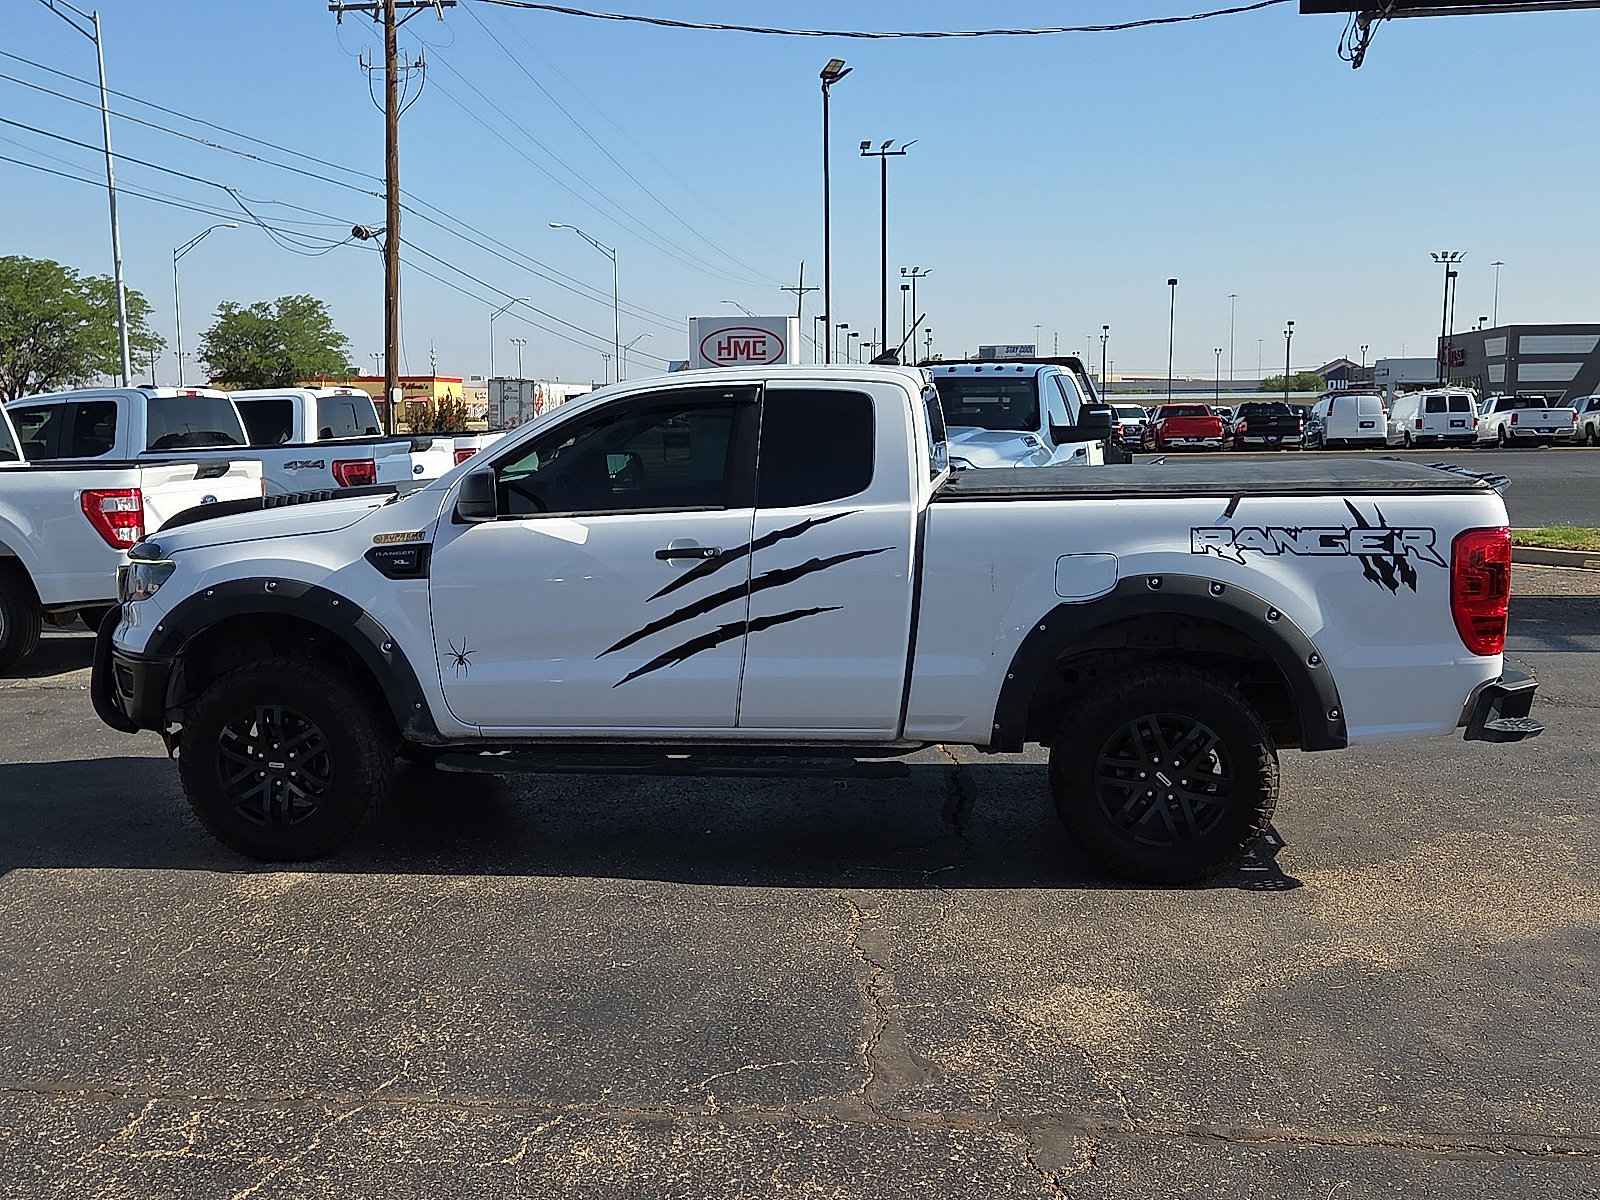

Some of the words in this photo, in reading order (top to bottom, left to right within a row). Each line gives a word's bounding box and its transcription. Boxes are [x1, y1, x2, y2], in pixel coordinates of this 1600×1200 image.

[717, 335, 767, 361] HMC
[1005, 345, 1019, 353] STAY
[1019, 345, 1033, 353] COOL
[1190, 526, 1449, 568] RANGER
